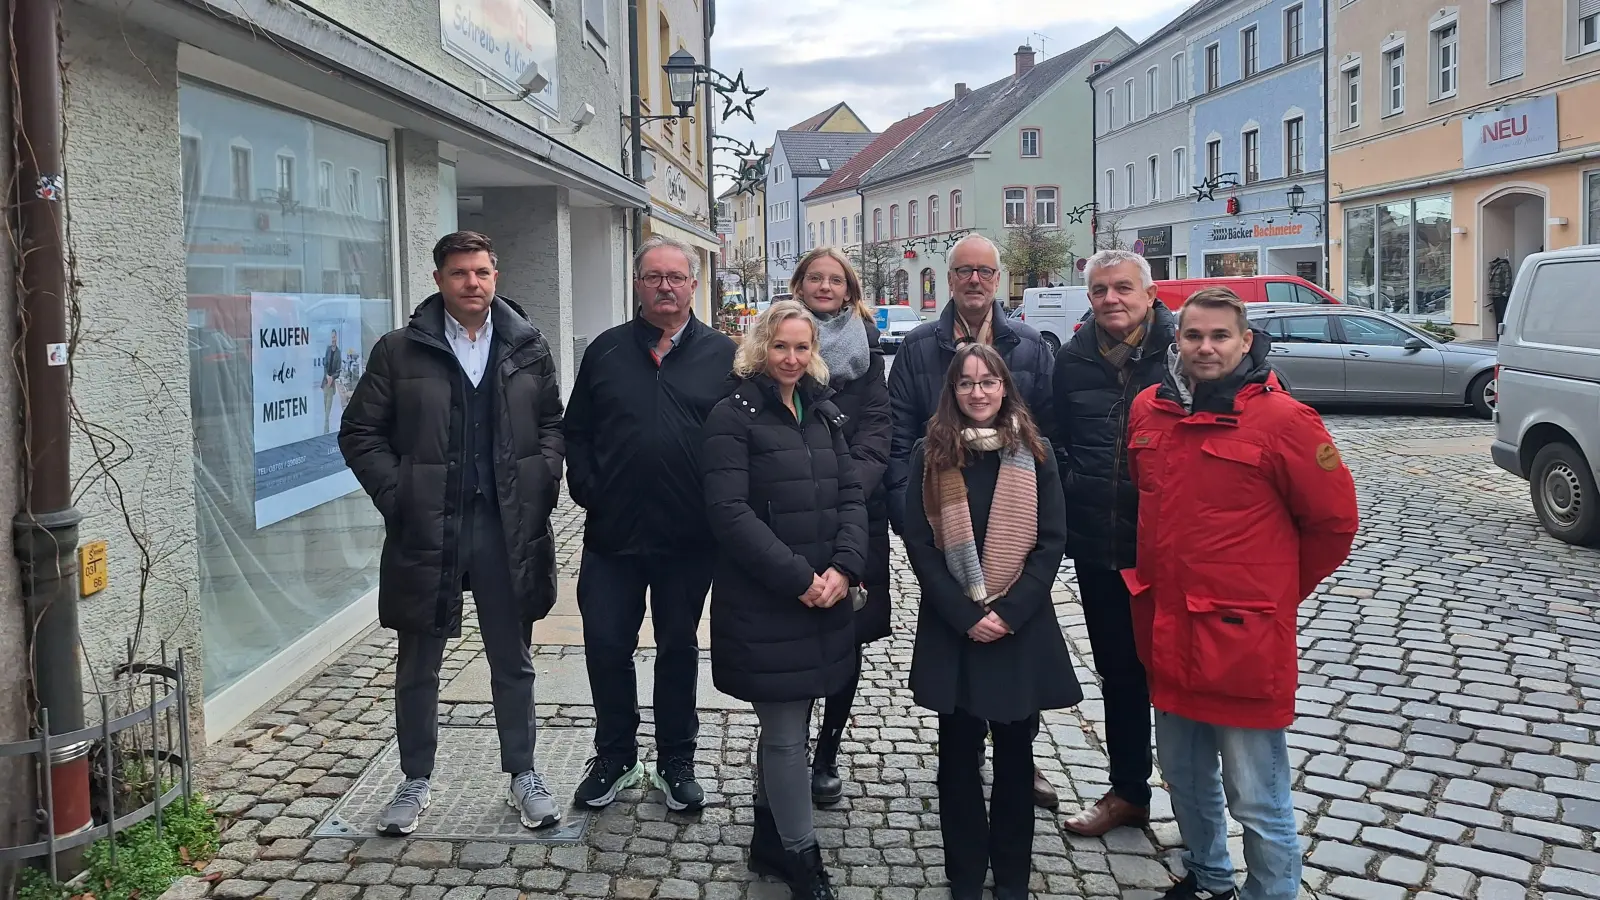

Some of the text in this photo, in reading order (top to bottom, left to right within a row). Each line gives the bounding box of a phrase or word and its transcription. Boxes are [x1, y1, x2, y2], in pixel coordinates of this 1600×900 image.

[453, 4, 500, 54] Schreib-
[504, 41, 511, 68] &
[1482, 114, 1528, 144] NEU
[1228, 221, 1303, 239] Bäcker Bachmeier
[260, 327, 309, 348] KAUFEN
[272, 361, 296, 384] oder
[263, 396, 308, 423] MIETEN
